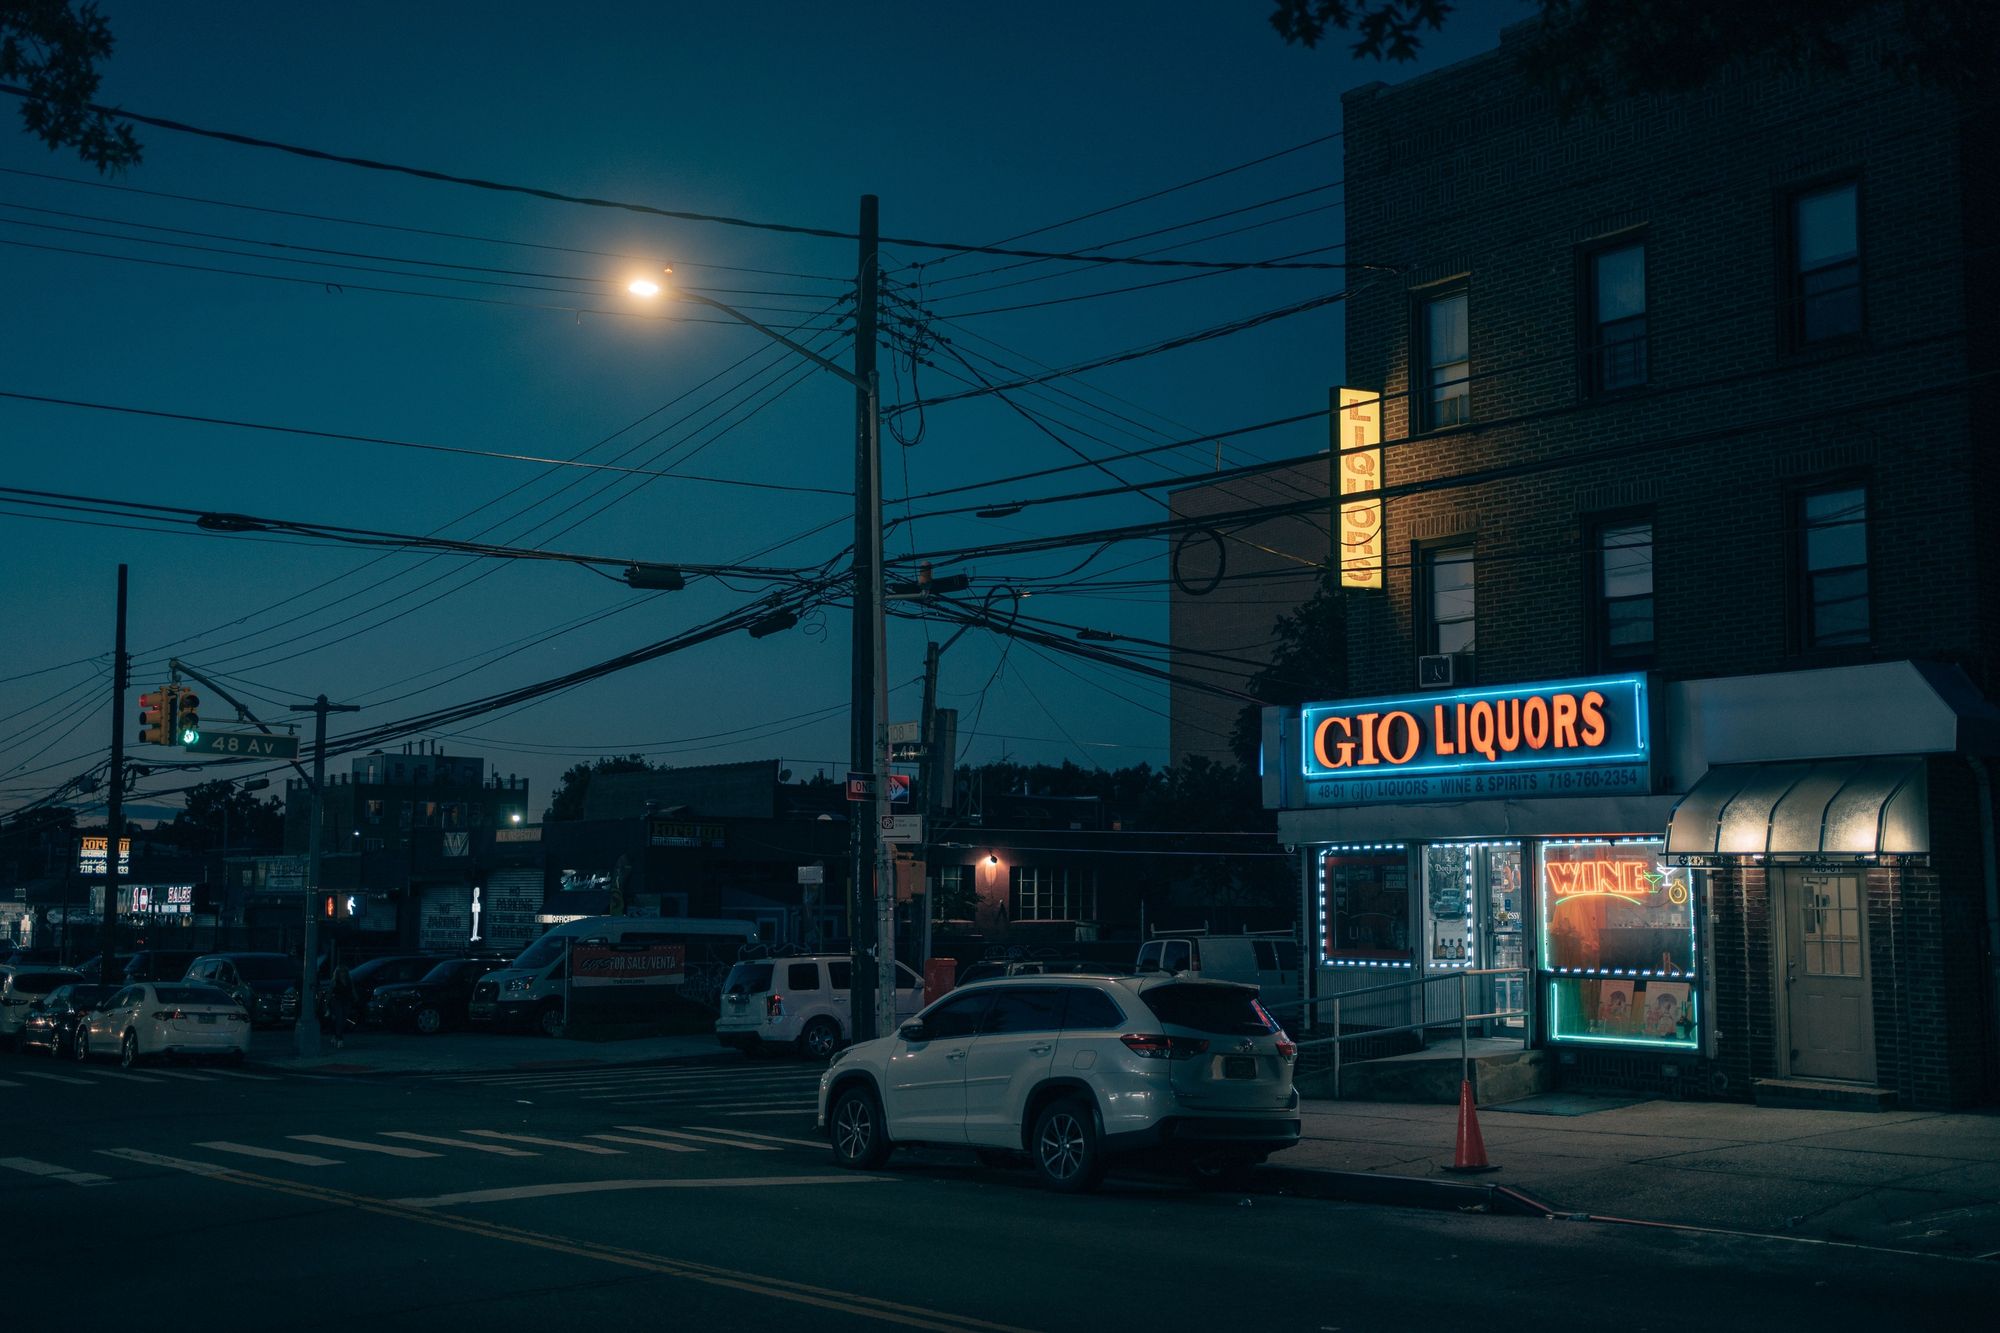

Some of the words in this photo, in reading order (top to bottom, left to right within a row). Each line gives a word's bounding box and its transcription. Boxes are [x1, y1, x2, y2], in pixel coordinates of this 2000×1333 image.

[1346, 399, 1375, 583] LIQUORS
[1314, 711, 1420, 768] GIO
[1434, 690, 1605, 762] LIQUORS
[211, 737, 238, 751] 48
[247, 738, 275, 754] Av
[900, 745, 915, 760] 48
[855, 781, 874, 793] ONE
[1318, 783, 1345, 799] 48-01
[1351, 781, 1374, 800] GIO
[1377, 778, 1429, 798] LIQUORS
[1440, 776, 1472, 794] WINE
[1475, 775, 1485, 791] &
[1488, 773, 1538, 792] SPIRITS
[1549, 768, 1638, 789] 718-760-2354
[1547, 861, 1645, 894] WINE
